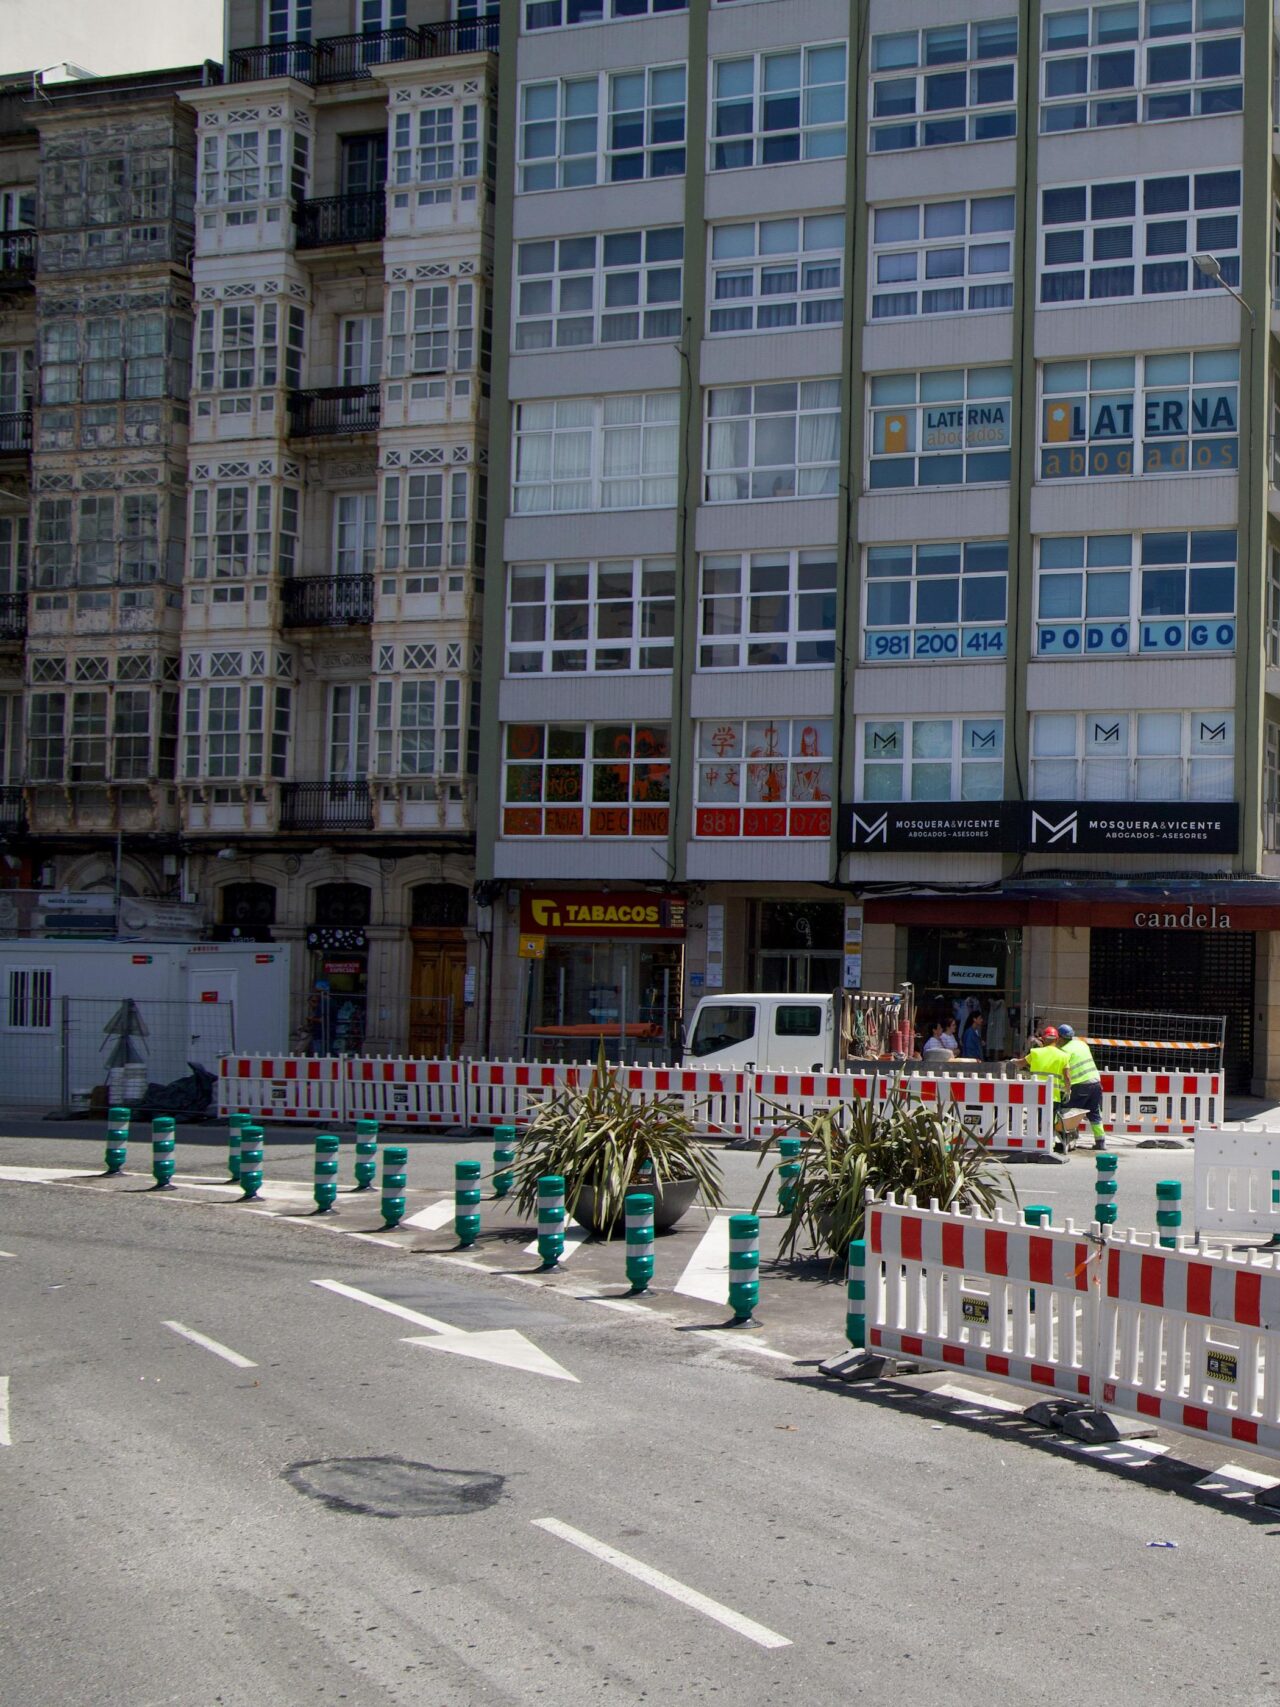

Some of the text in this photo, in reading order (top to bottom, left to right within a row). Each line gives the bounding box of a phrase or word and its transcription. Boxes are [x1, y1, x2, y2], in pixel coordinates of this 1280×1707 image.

[927, 407, 1004, 428] LATERNA
[1073, 397, 1234, 436] LATERNA
[927, 425, 1004, 448] abogados
[1046, 442, 1233, 476] abogados
[875, 635, 911, 655] 981
[916, 633, 958, 654] 200
[966, 631, 1003, 651] 414
[1040, 623, 1234, 650] PODÓLOGO
[712, 727, 736, 757] 学
[705, 768, 739, 787] 中文
[703, 813, 830, 833] 881 912 078
[895, 819, 1001, 830] MOSQUERA&VICENTE
[1089, 820, 1221, 831] MOSQUERA&VICENTE
[952, 830, 990, 838] ASESORES
[1105, 832, 1208, 840] ABOGADOS ASESORES
[566, 905, 660, 922] TABACOS
[1134, 905, 1232, 929] candela
[951, 971, 995, 979] SKECHERS
